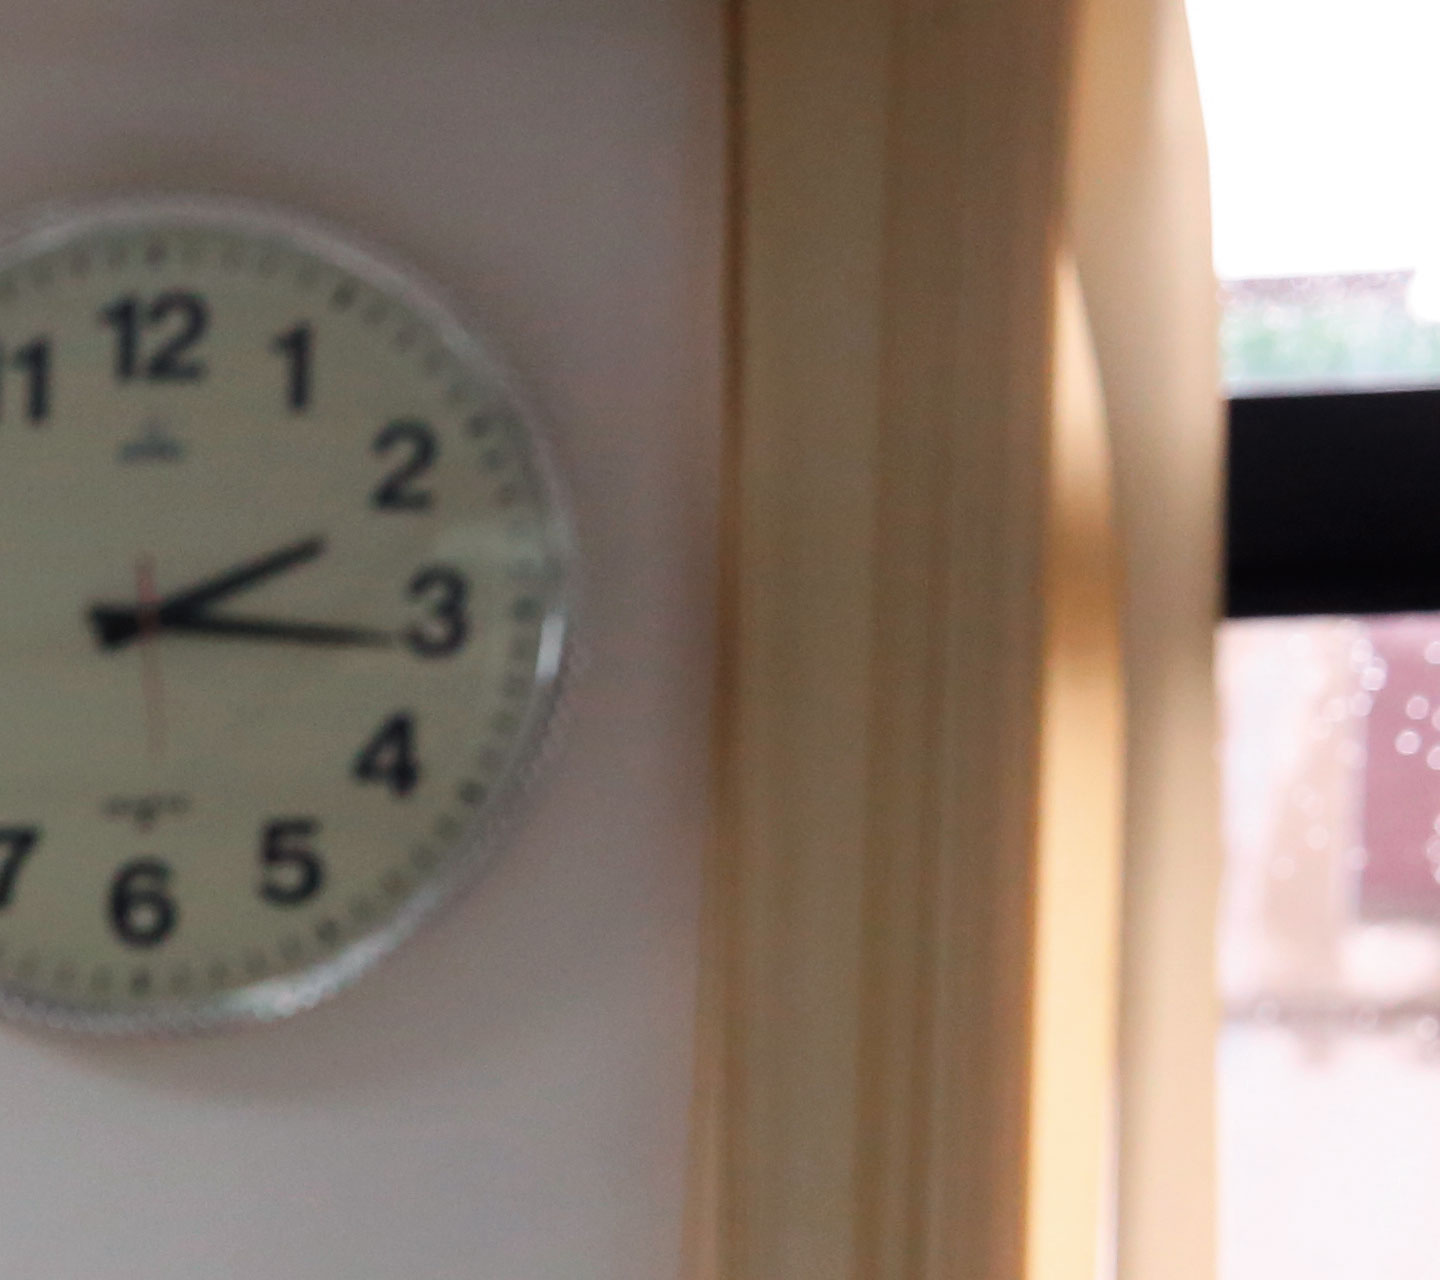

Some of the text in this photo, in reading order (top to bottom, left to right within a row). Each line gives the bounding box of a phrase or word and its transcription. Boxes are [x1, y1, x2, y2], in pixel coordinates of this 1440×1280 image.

[103, 291, 209, 383] 12
[275, 324, 313, 412] 1
[372, 420, 438, 512] 2
[402, 566, 470, 659] 3
[353, 713, 421, 798] 4
[107, 860, 177, 949] 6
[260, 818, 325, 907] 5
